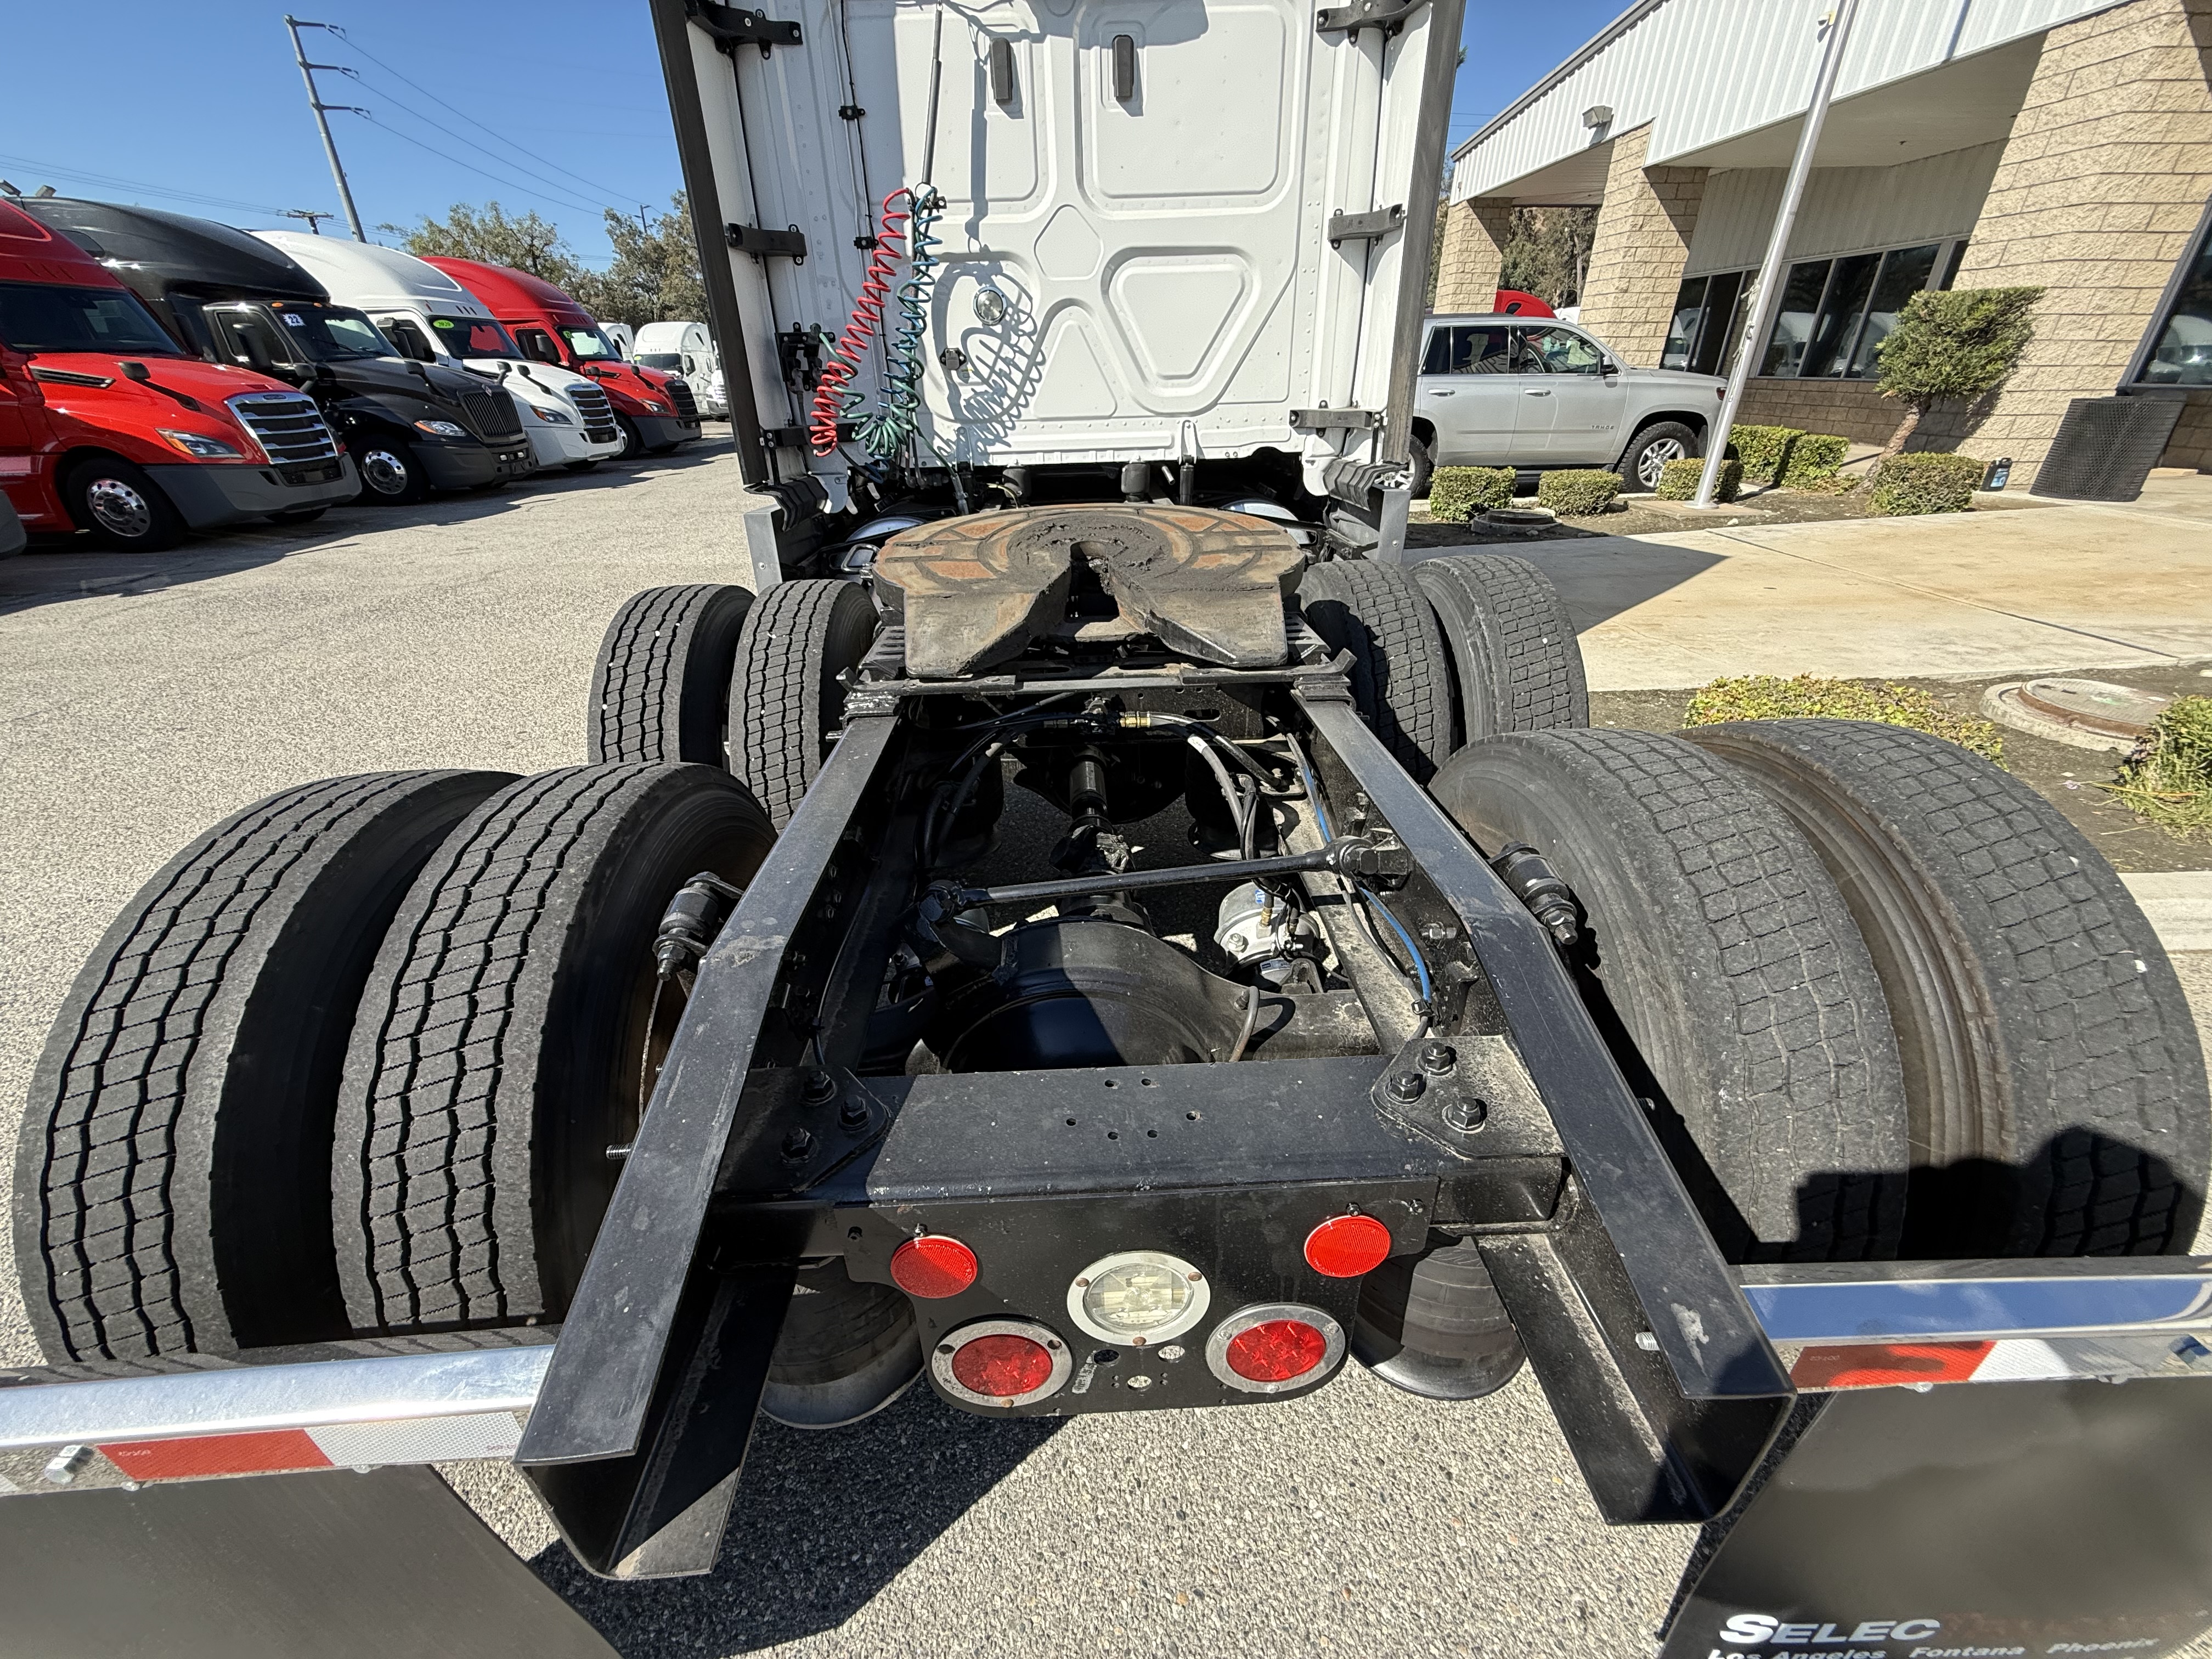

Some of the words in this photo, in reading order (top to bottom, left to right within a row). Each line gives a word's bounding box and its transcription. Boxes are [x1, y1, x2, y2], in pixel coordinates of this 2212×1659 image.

[288, 315, 301, 324] 22
[1707, 1649, 1763, 1659] Los
[1770, 1649, 1888, 1659] Angeles
[1908, 1646, 2026, 1658] Fontana
[2045, 1638, 2160, 1654] Phoenix
